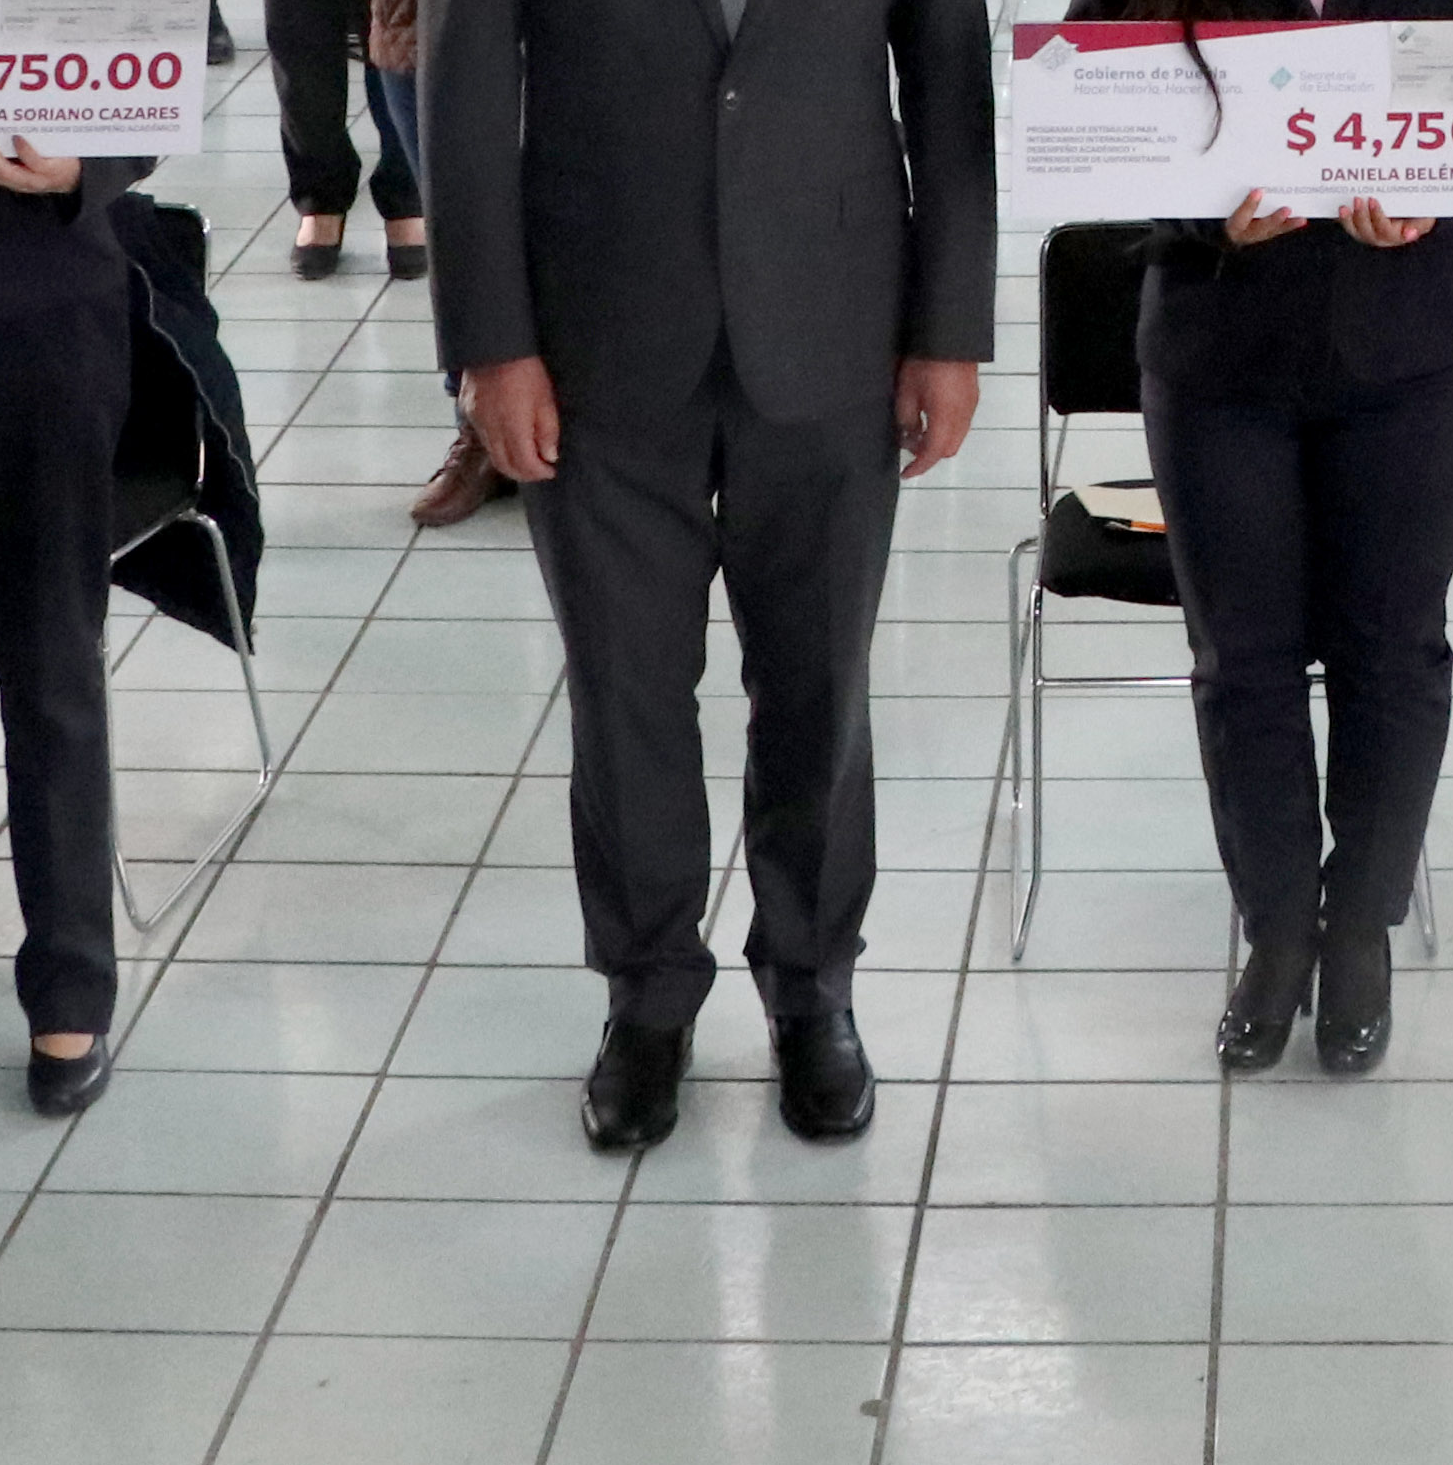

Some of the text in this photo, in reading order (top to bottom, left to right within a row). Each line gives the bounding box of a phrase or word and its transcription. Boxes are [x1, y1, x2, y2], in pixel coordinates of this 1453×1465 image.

[1074, 67, 1146, 80] Gobierno
[1150, 67, 1171, 80] de
[13, 108, 95, 122] SORIANO
[98, 106, 181, 120] CAZARES
[1286, 107, 1316, 156] $
[1321, 167, 1400, 182] DANIELA
